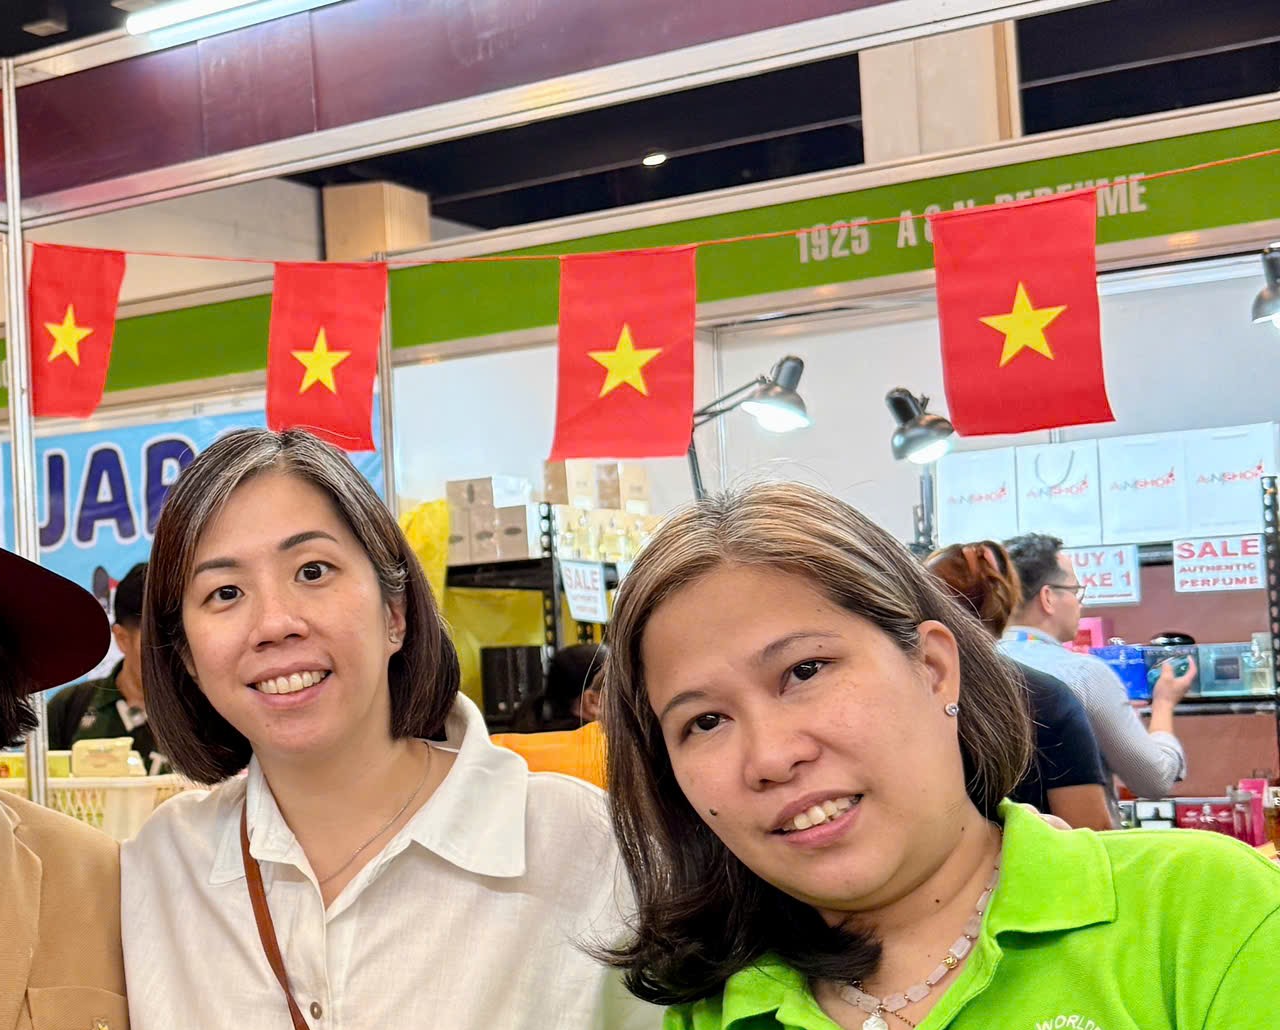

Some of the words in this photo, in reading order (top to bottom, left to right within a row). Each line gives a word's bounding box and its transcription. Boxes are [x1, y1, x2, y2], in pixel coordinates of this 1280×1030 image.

[795, 216, 870, 264] 1925
[896, 209, 918, 249] A
[39, 436, 197, 547] JAP
[1176, 538, 1260, 560] SALE
[1073, 552, 1105, 568] UY
[1114, 550, 1125, 566] 1
[1178, 562, 1257, 574] AUTHENTIC
[1121, 570, 1132, 587] 1
[1179, 575, 1259, 588] PERFUME
